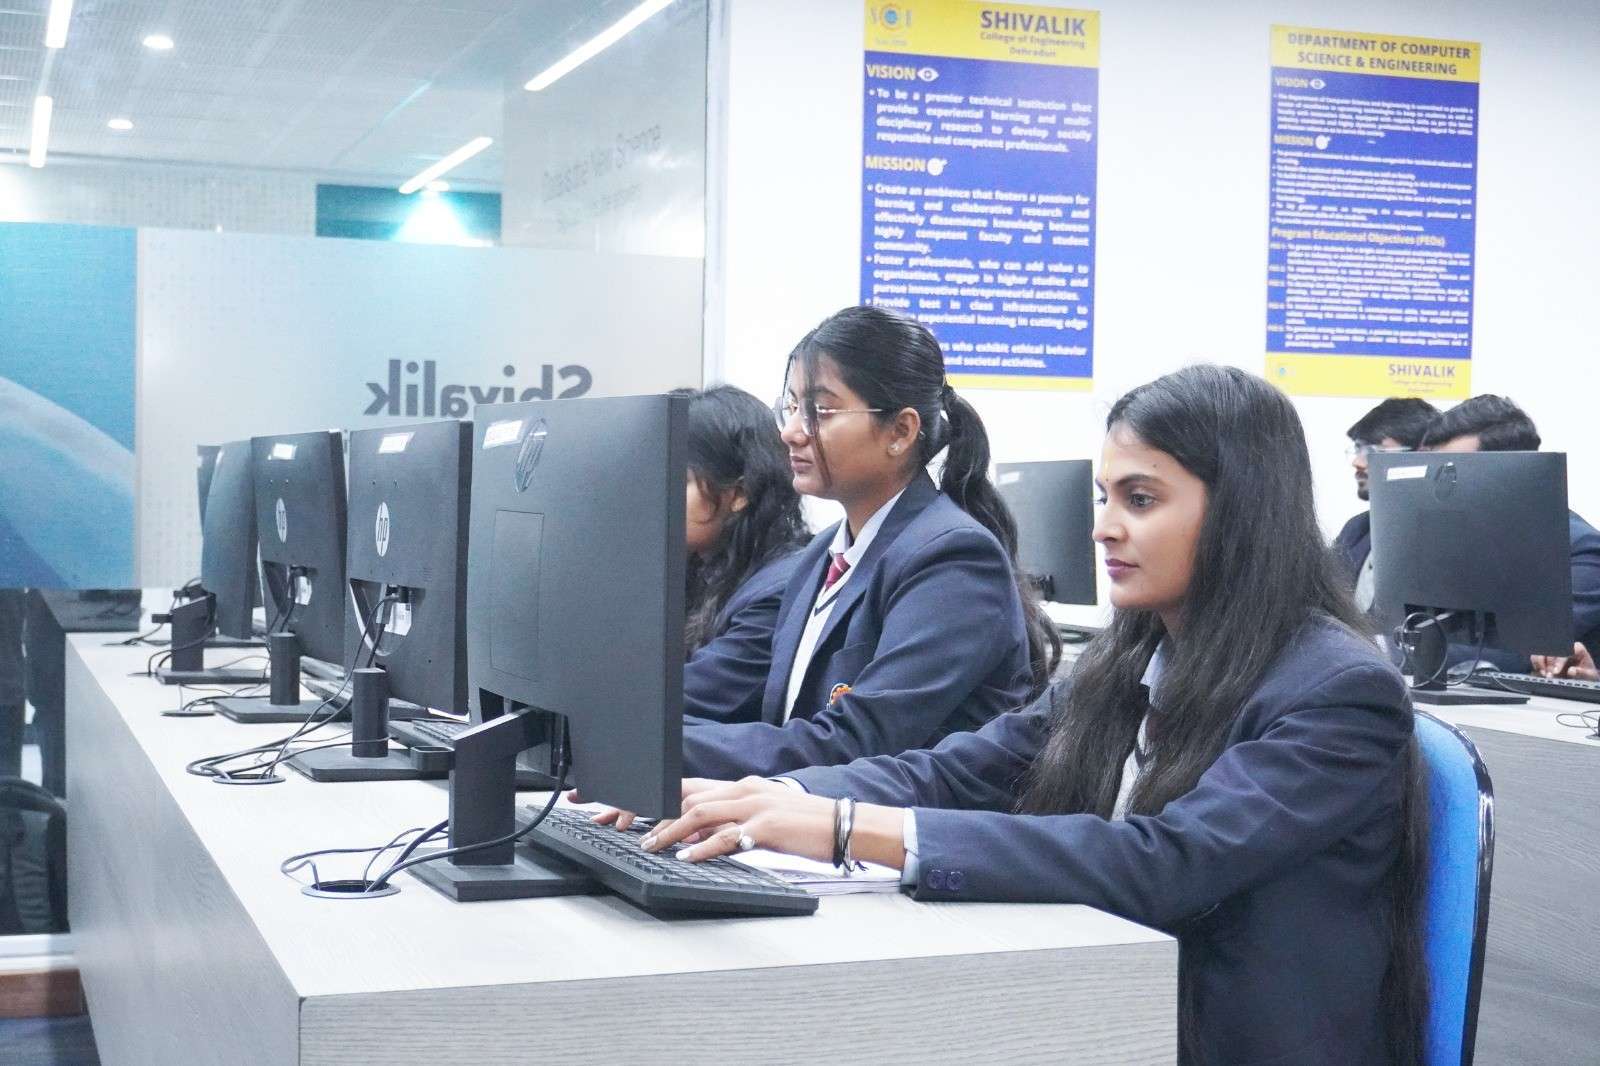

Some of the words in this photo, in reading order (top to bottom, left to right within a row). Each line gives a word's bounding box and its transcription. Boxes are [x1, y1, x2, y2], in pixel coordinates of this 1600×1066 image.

[980, 10, 1087, 37] SHIVALIK
[980, 32, 1015, 43] College
[1018, 35, 1029, 43] of
[1030, 36, 1086, 49] Engineering
[1287, 33, 1376, 51] DEPARTMENT
[1381, 42, 1396, 52] OF
[1401, 43, 1471, 59] COMPUTER
[1009, 47, 1057, 58] Dehradun
[866, 64, 916, 80] VISION
[1298, 52, 1351, 66] SCIENCE
[1356, 58, 1365, 67] &
[1370, 59, 1457, 75] ENGINEERING
[877, 88, 889, 98] To
[969, 95, 1012, 107] technical
[877, 104, 918, 115] provides
[927, 107, 983, 120] experiential
[992, 111, 1030, 125] learning
[1038, 114, 1055, 124] and
[877, 118, 932, 131] disciplinary
[941, 122, 982, 132] research
[1012, 126, 1049, 139] develop
[1058, 129, 1092, 142] socially
[933, 135, 951, 145] and
[865, 155, 925, 172] MISSION
[875, 183, 907, 195] Create
[875, 198, 915, 211] learning
[924, 201, 943, 211] and
[1022, 207, 1062, 217] research
[1071, 208, 1090, 219] and
[875, 213, 925, 226] effectively
[875, 226, 904, 239] highly
[979, 231, 1012, 245] faculty
[1023, 234, 1042, 244] and
[1388, 364, 1456, 377] SHIVALIK
[376, 504, 390, 554] hp
